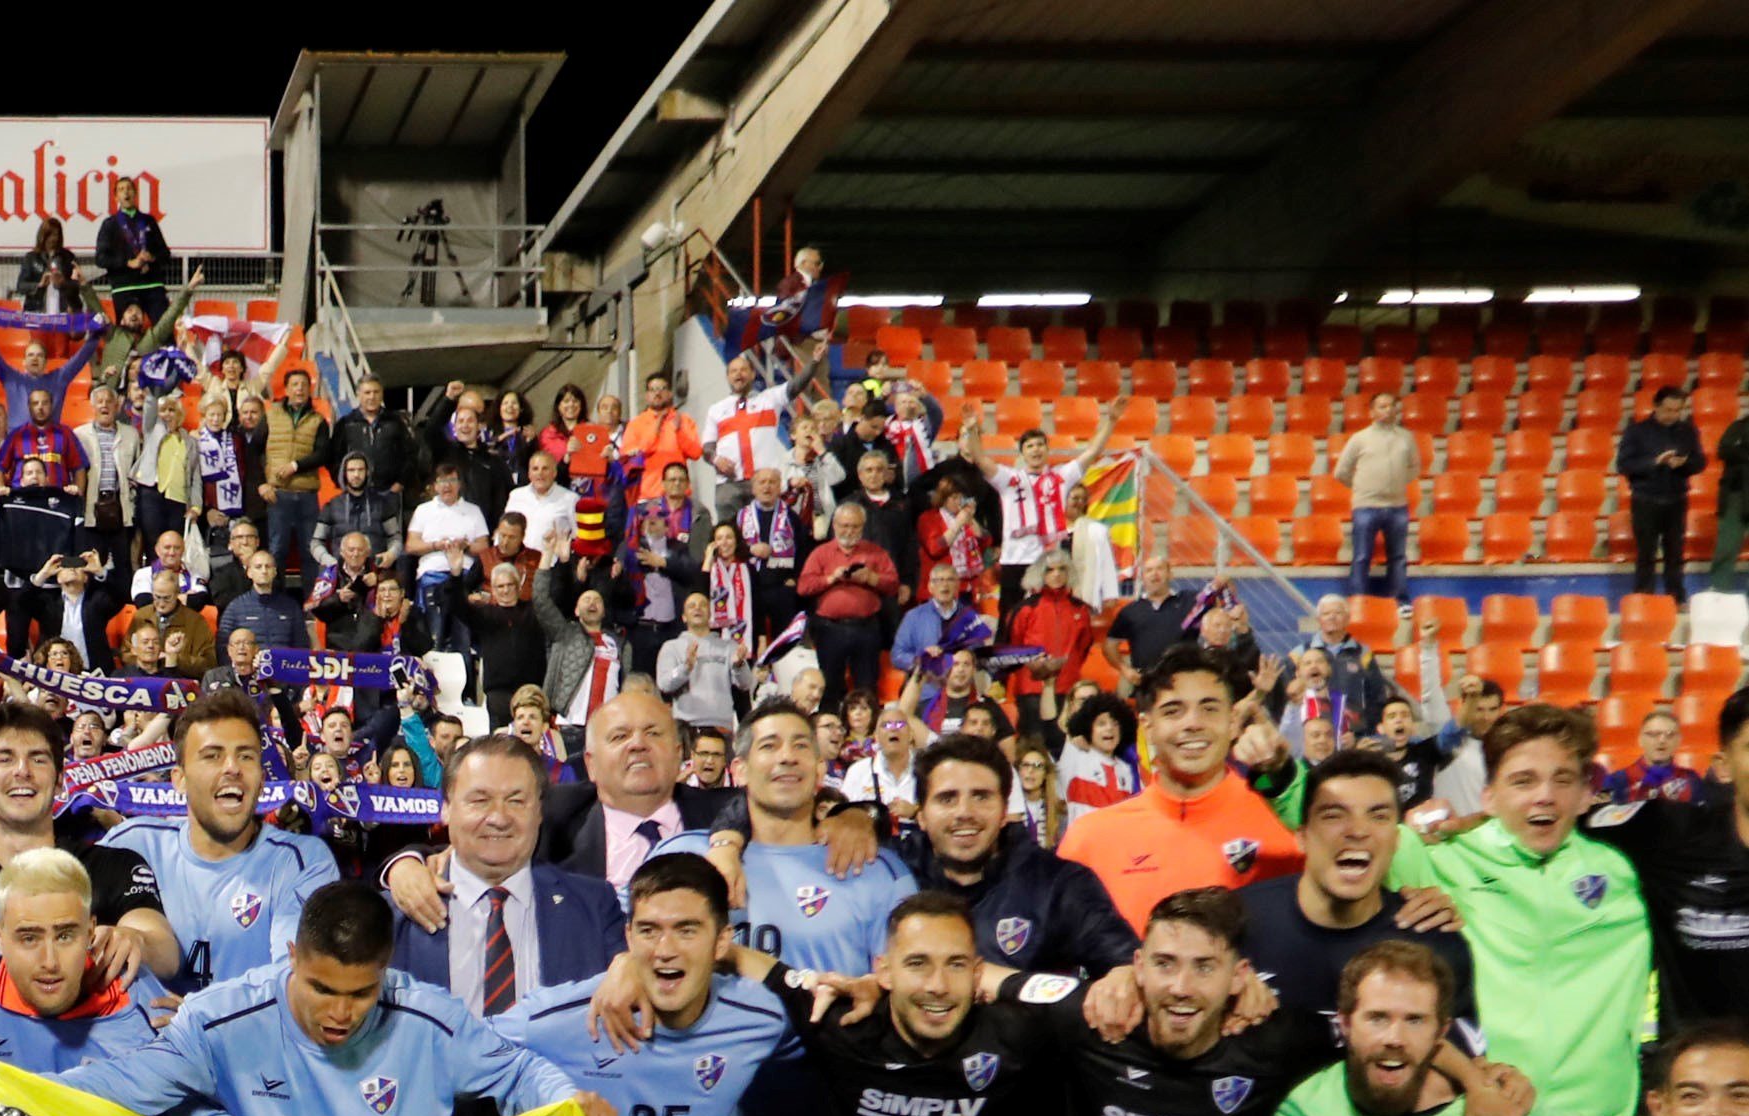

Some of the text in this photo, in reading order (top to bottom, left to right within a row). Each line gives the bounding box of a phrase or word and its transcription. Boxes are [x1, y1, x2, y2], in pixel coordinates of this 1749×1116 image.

[308, 656, 353, 680] SDH
[11, 658, 153, 708] HUESCA
[128, 786, 188, 805] VAMO
[369, 795, 440, 815] VAMOS
